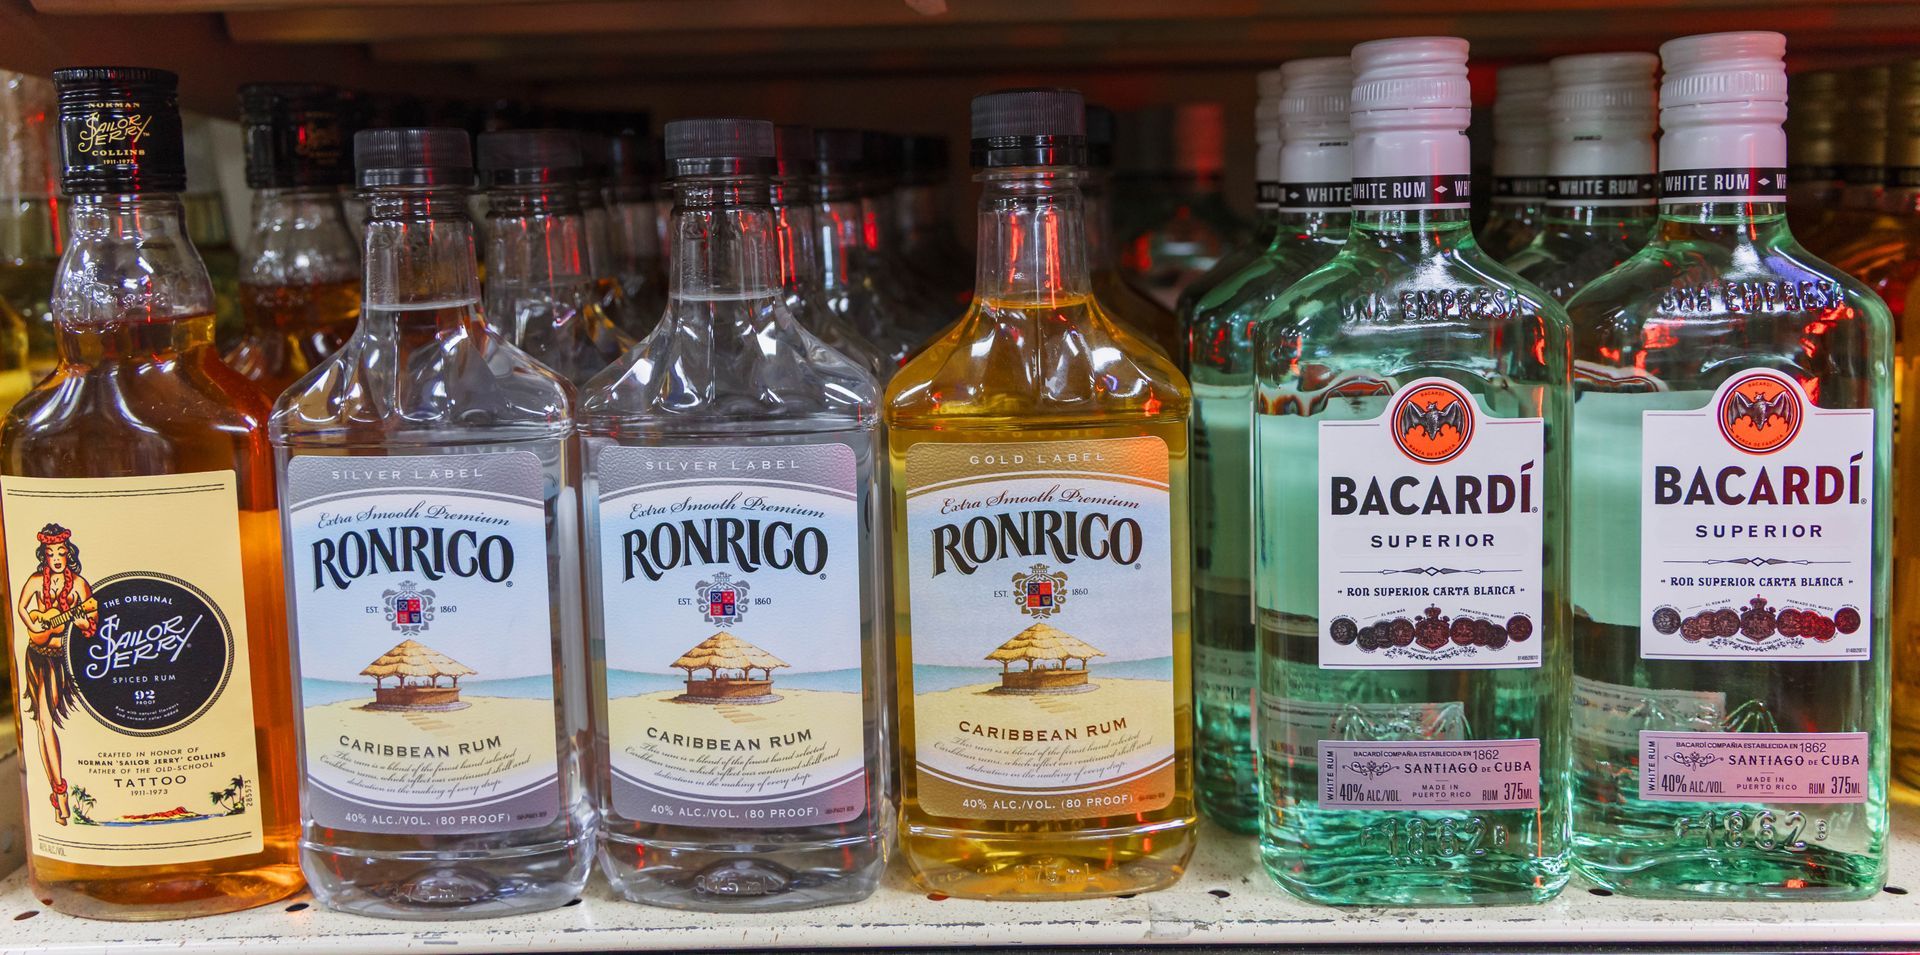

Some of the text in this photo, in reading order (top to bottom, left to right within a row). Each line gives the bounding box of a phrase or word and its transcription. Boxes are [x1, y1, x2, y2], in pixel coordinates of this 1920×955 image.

[1559, 180, 1604, 195] WHITE
[1608, 179, 1639, 194] RUM
[1665, 173, 1749, 192] WHITE RUM
[1352, 183, 1387, 200] WHITE
[1393, 181, 1426, 198] RUM
[1401, 287, 1522, 322] EMPRESA
[646, 459, 800, 471] SILVER LABEL
[969, 452, 1105, 465] GOLD LABEL
[332, 468, 483, 480] SILVER LABEL
[1655, 450, 1864, 505] BACARDÍ
[1331, 459, 1535, 516] BACARDÍ
[629, 491, 826, 520] Extra Smooth Premium
[940, 484, 1140, 515] Extra Smooth Premium
[318, 500, 510, 529] Extra Smooth Premium
[1695, 525, 1823, 538] SUPERIOR
[930, 509, 1143, 578] RONRICO
[1370, 533, 1495, 548] SUPERIOR
[621, 517, 829, 583] RONRICO
[311, 526, 515, 592] RONRICO
[1670, 576, 1844, 587] RON SUPERIOR CARTA BLANCA
[994, 588, 1089, 598] EST. 1860
[1346, 585, 1516, 597] RON SUPERIOR CARTA BLANCA
[104, 595, 174, 609] THE ORIGINAL
[755, 597, 772, 605] 1860
[440, 605, 457, 613] 1860
[89, 614, 185, 658] SAILOR
[86, 614, 203, 679] JERRY
[112, 674, 176, 684] SPICED RUM
[134, 689, 156, 700] 92
[958, 717, 1128, 742] CARIBBEAN RUM
[339, 735, 502, 758] CARIBBEAN RUM
[647, 727, 812, 751] CARIBBEAN RUM
[1473, 749, 1500, 760] 1862
[1799, 742, 1827, 753] 1862
[187, 751, 226, 761] COLLINS
[1728, 754, 1804, 766] SANTIAGO
[1821, 755, 1860, 766] CUBA
[155, 761, 214, 773] OLD-SCHOOL
[1404, 762, 1478, 774] SANTIAGO
[1494, 761, 1532, 773] CUBA
[114, 775, 187, 788] TATTOO
[1661, 774, 1687, 793] 40%
[1808, 776, 1861, 794] RUM 375ML
[130, 788, 168, 796] 1911-1973
[1339, 783, 1365, 802] 40%
[1482, 782, 1533, 801] RUM 375ML
[962, 798, 987, 810] 40%
[993, 799, 1056, 811] ALC./VOL.
[1061, 797, 1081, 810] (80
[1086, 794, 1133, 806] PROOF)
[345, 813, 367, 824] 40%
[372, 814, 431, 825] ALC./VOL.
[436, 815, 456, 826] (80
[461, 813, 511, 825] PROOF)
[651, 805, 674, 816] 40%
[679, 807, 739, 818] ALC./VOL.
[744, 809, 765, 819] (80
[770, 806, 819, 819] PROOF)
[1699, 809, 1808, 851] 1862
